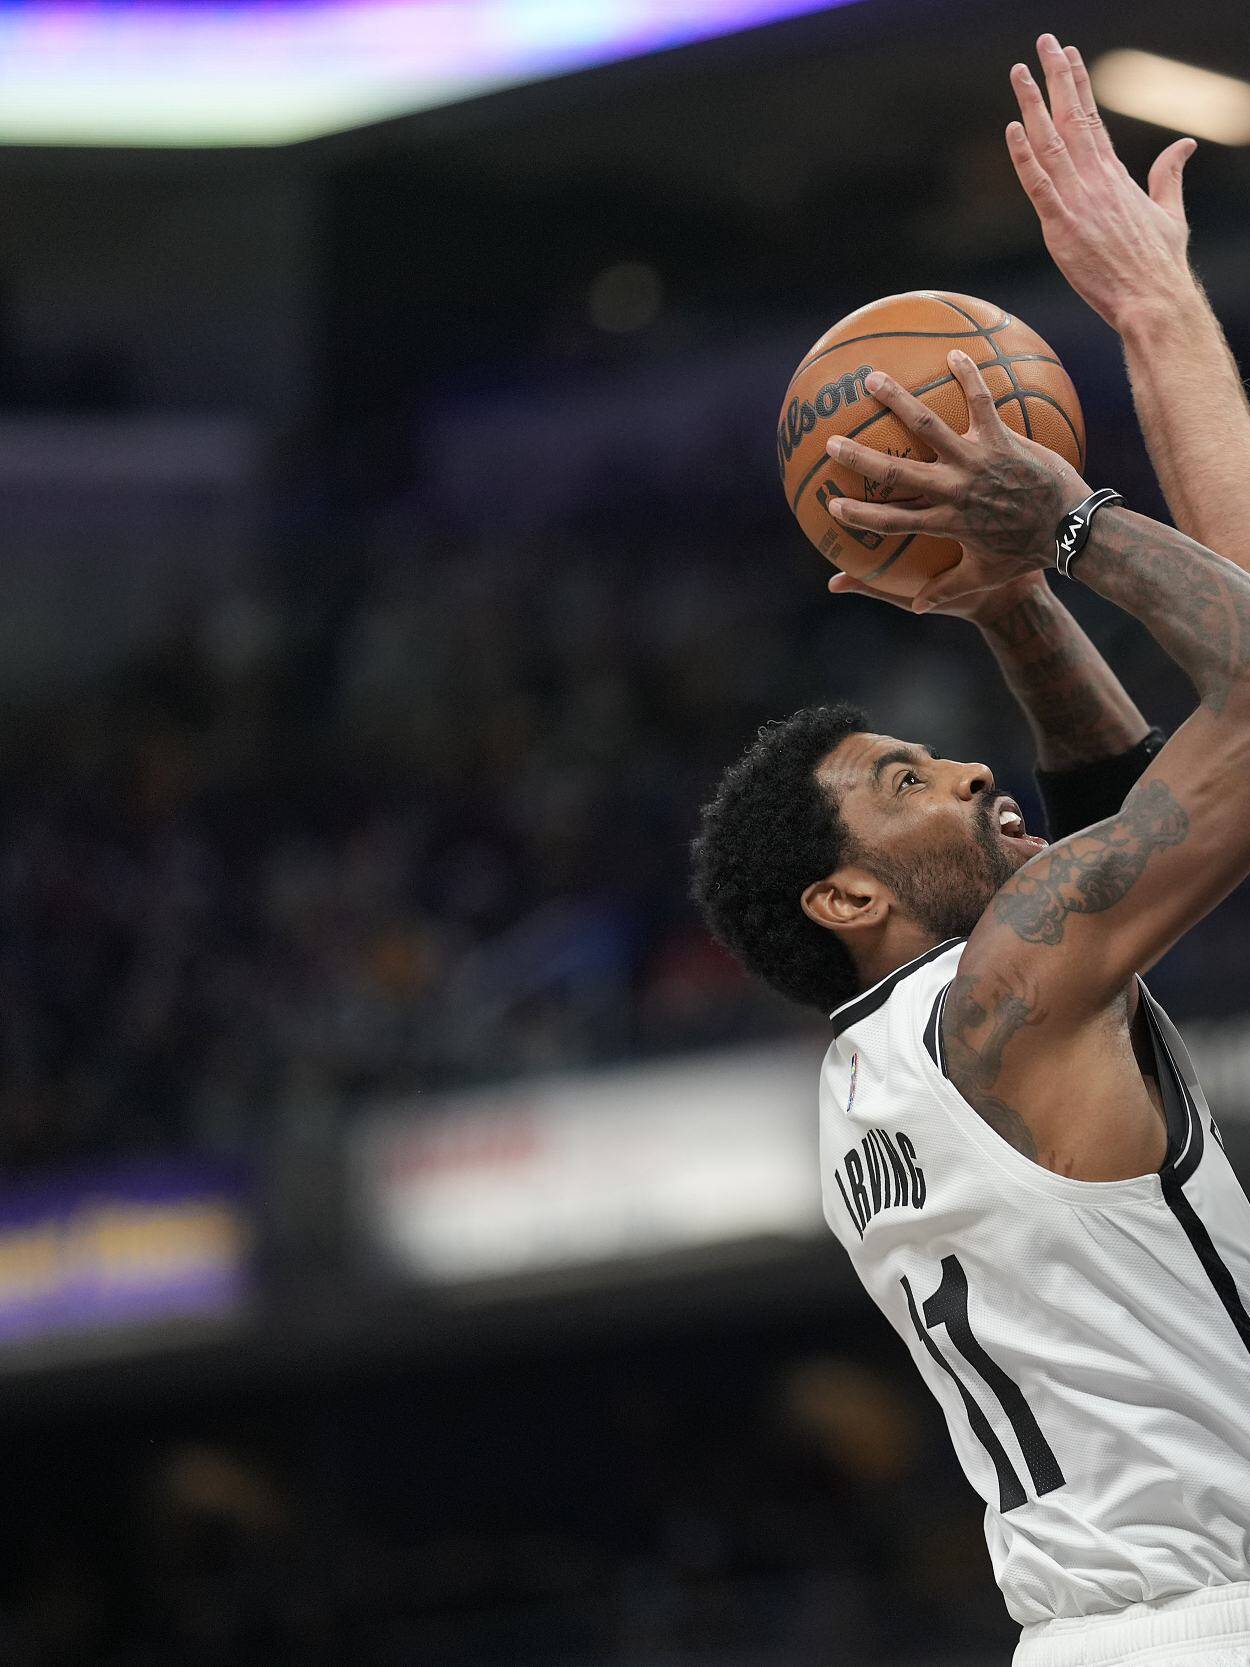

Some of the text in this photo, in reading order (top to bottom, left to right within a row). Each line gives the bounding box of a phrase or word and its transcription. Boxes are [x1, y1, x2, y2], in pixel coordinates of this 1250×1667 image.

[777, 364, 873, 472] ilson
[834, 1128, 927, 1241] IRVING
[900, 1253, 1067, 1515] 11
